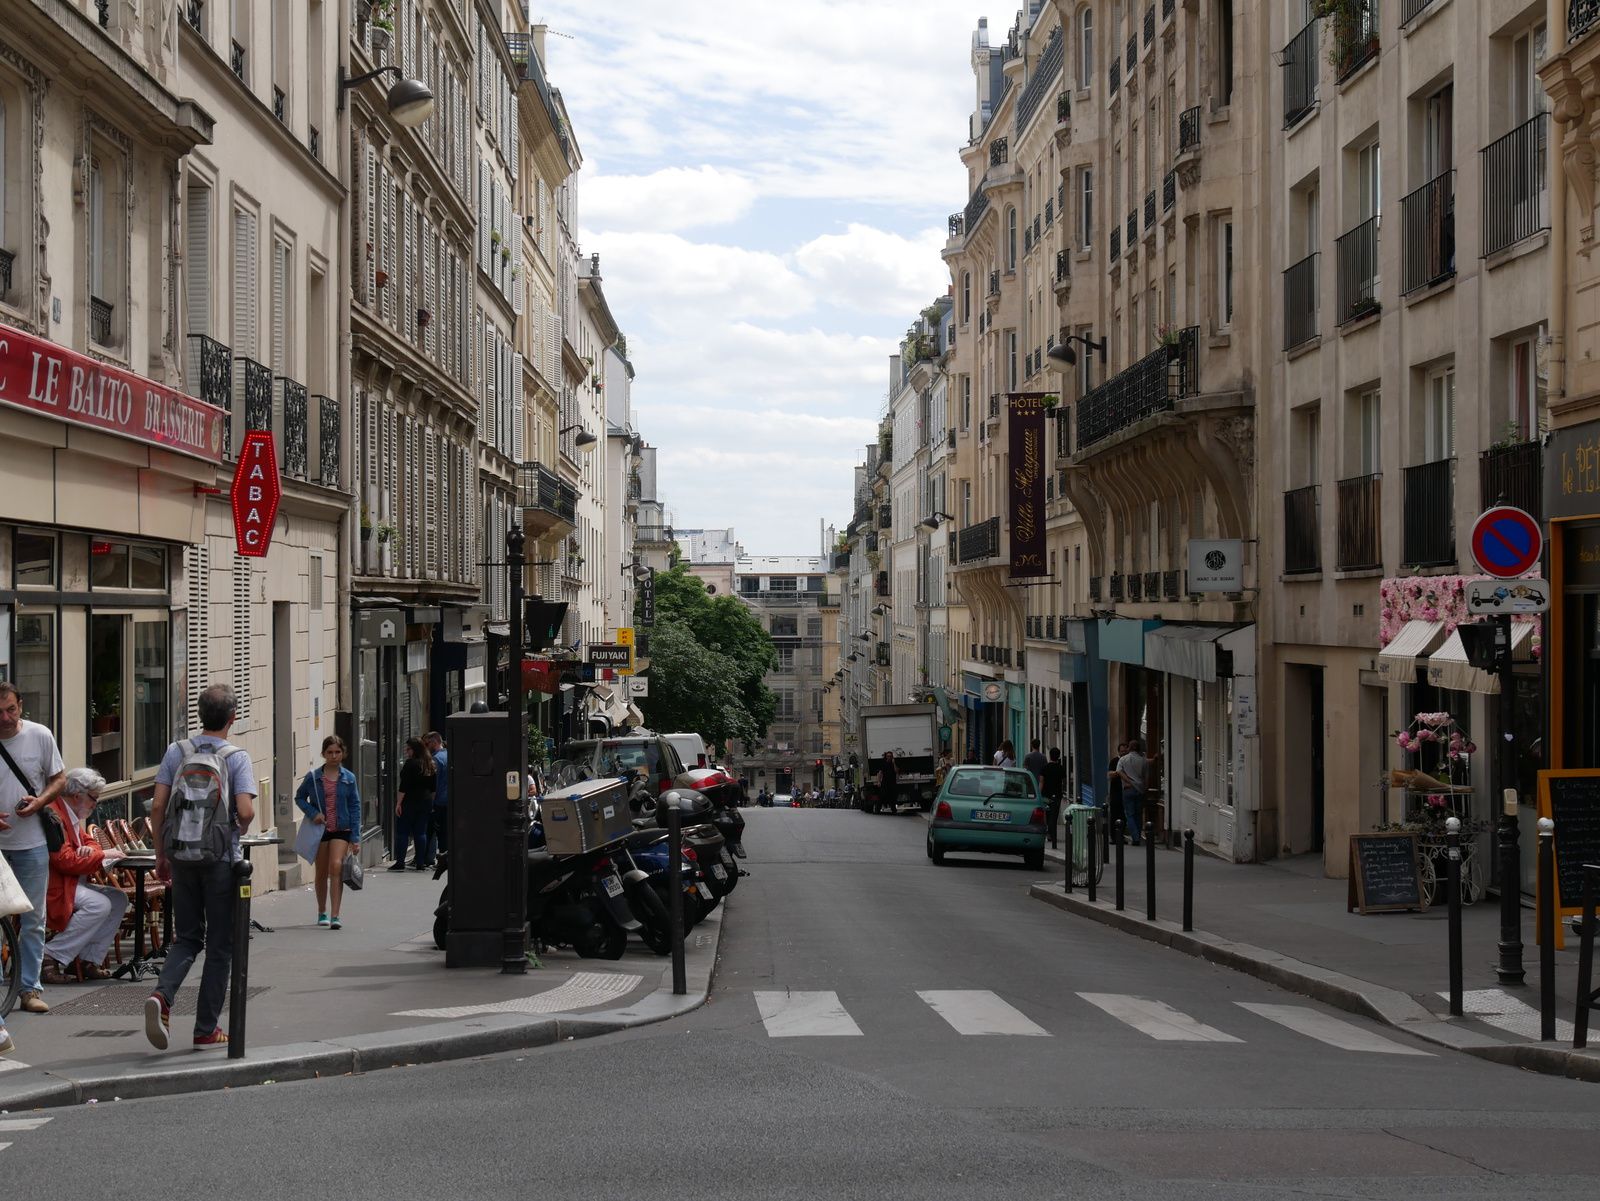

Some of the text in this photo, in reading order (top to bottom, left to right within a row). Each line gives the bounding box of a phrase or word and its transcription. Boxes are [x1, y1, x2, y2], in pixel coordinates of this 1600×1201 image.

[28, 351, 62, 406] LE
[68, 366, 132, 426] BALTO
[143, 390, 206, 449] BRASSERIE
[1009, 396, 1043, 408] HÔTEL
[1015, 428, 1038, 498] Margaux
[245, 441, 265, 546] TABAC
[644, 571, 652, 618] OTEL
[591, 651, 627, 660] FUJIYAKI
